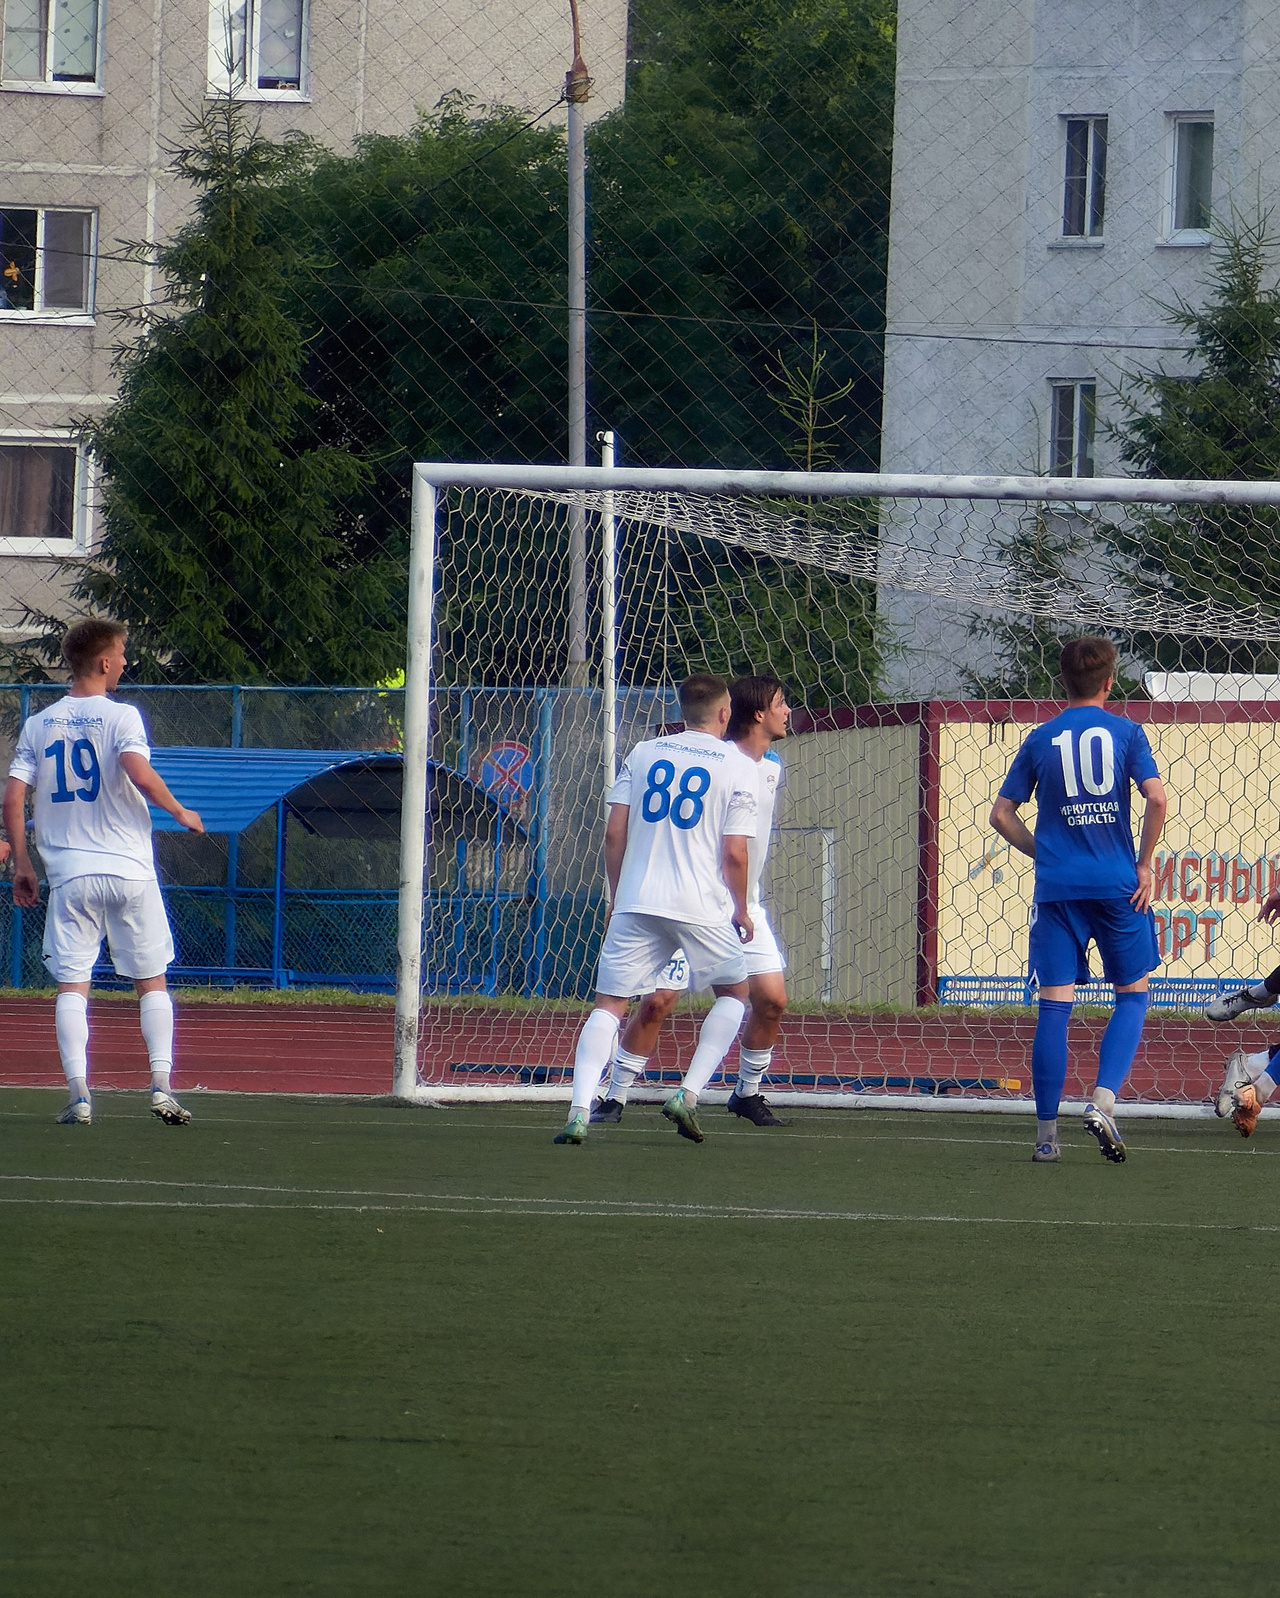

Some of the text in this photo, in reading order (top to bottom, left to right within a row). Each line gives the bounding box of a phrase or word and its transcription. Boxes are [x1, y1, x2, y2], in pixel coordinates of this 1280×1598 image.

[44, 738, 100, 803] 19
[1051, 726, 1115, 798] 10
[641, 758, 712, 831] 88
[1060, 801, 1119, 816] ИРКУТСКАЯ
[1067, 813, 1116, 826] ОБЛАСТЬ
[1154, 909, 1223, 961] ОРТ
[667, 959, 685, 981] 75
